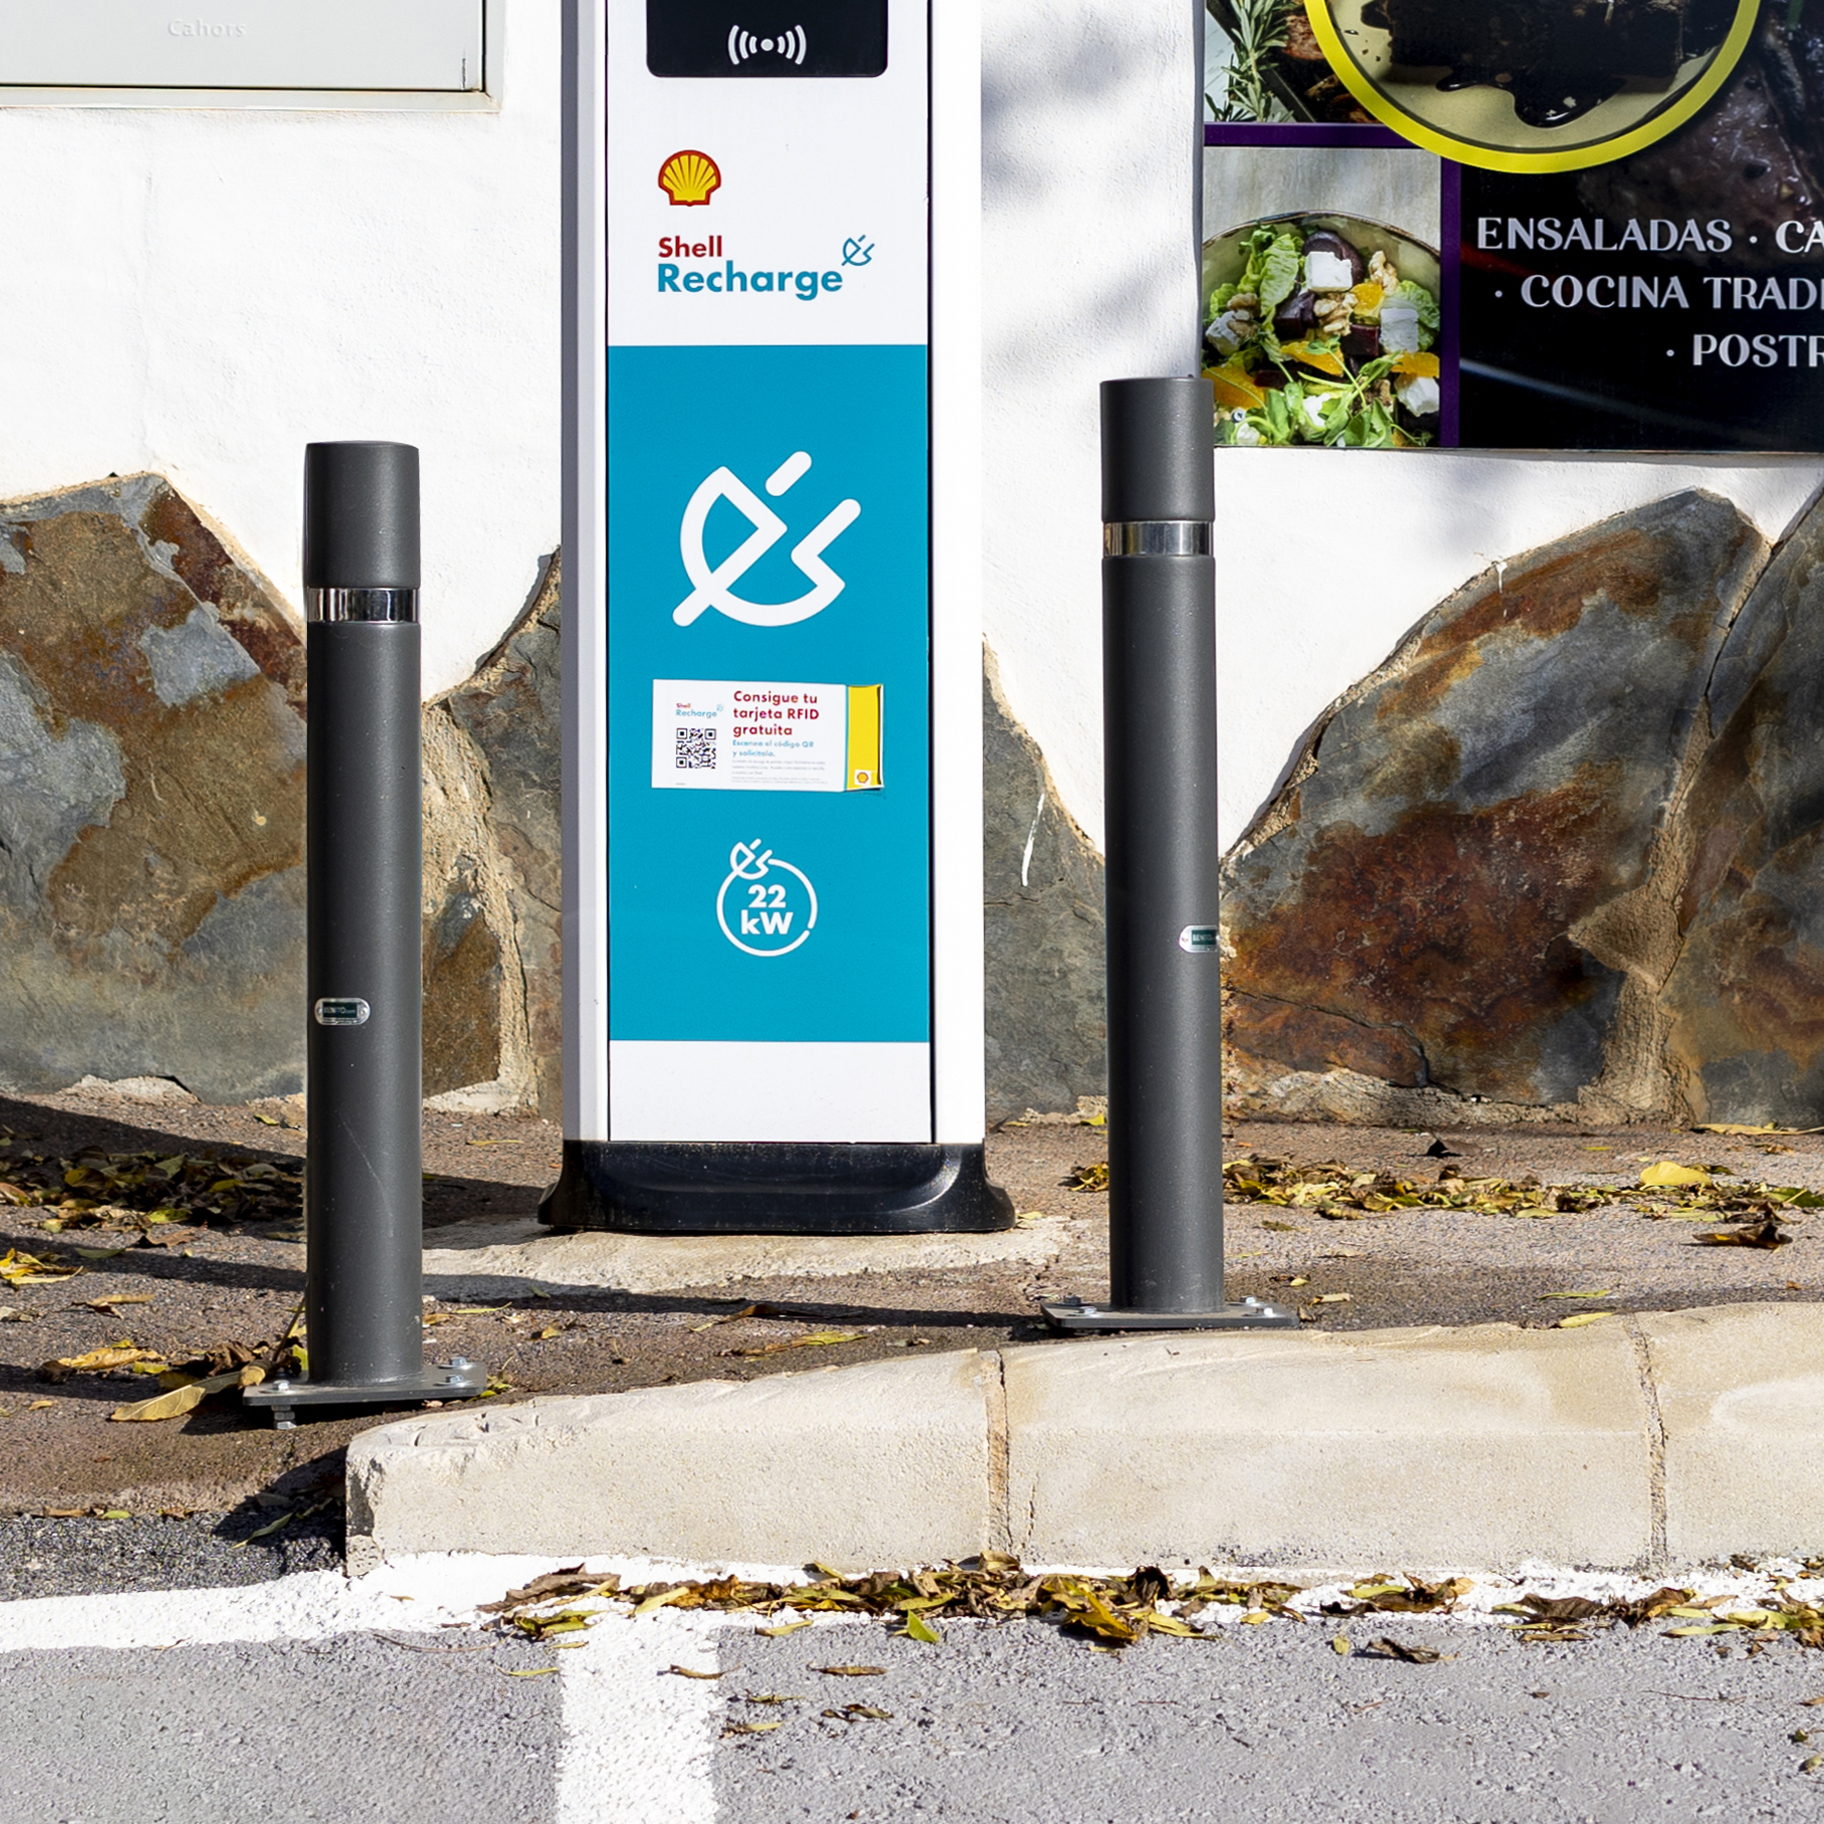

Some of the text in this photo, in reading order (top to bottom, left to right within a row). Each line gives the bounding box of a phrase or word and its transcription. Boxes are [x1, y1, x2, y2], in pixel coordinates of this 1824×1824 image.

[167, 18, 247, 38] Cahors
[658, 234, 723, 258] Shell
[1477, 217, 1733, 251] ENSALADAS
[657, 260, 843, 301] Recharge
[1521, 274, 1690, 309] COCINA
[733, 690, 818, 706] Consigue tu
[733, 706, 820, 722] tarjeta RFID
[733, 723, 793, 738] gratuita
[748, 884, 786, 908] 22
[741, 909, 794, 935] kW
